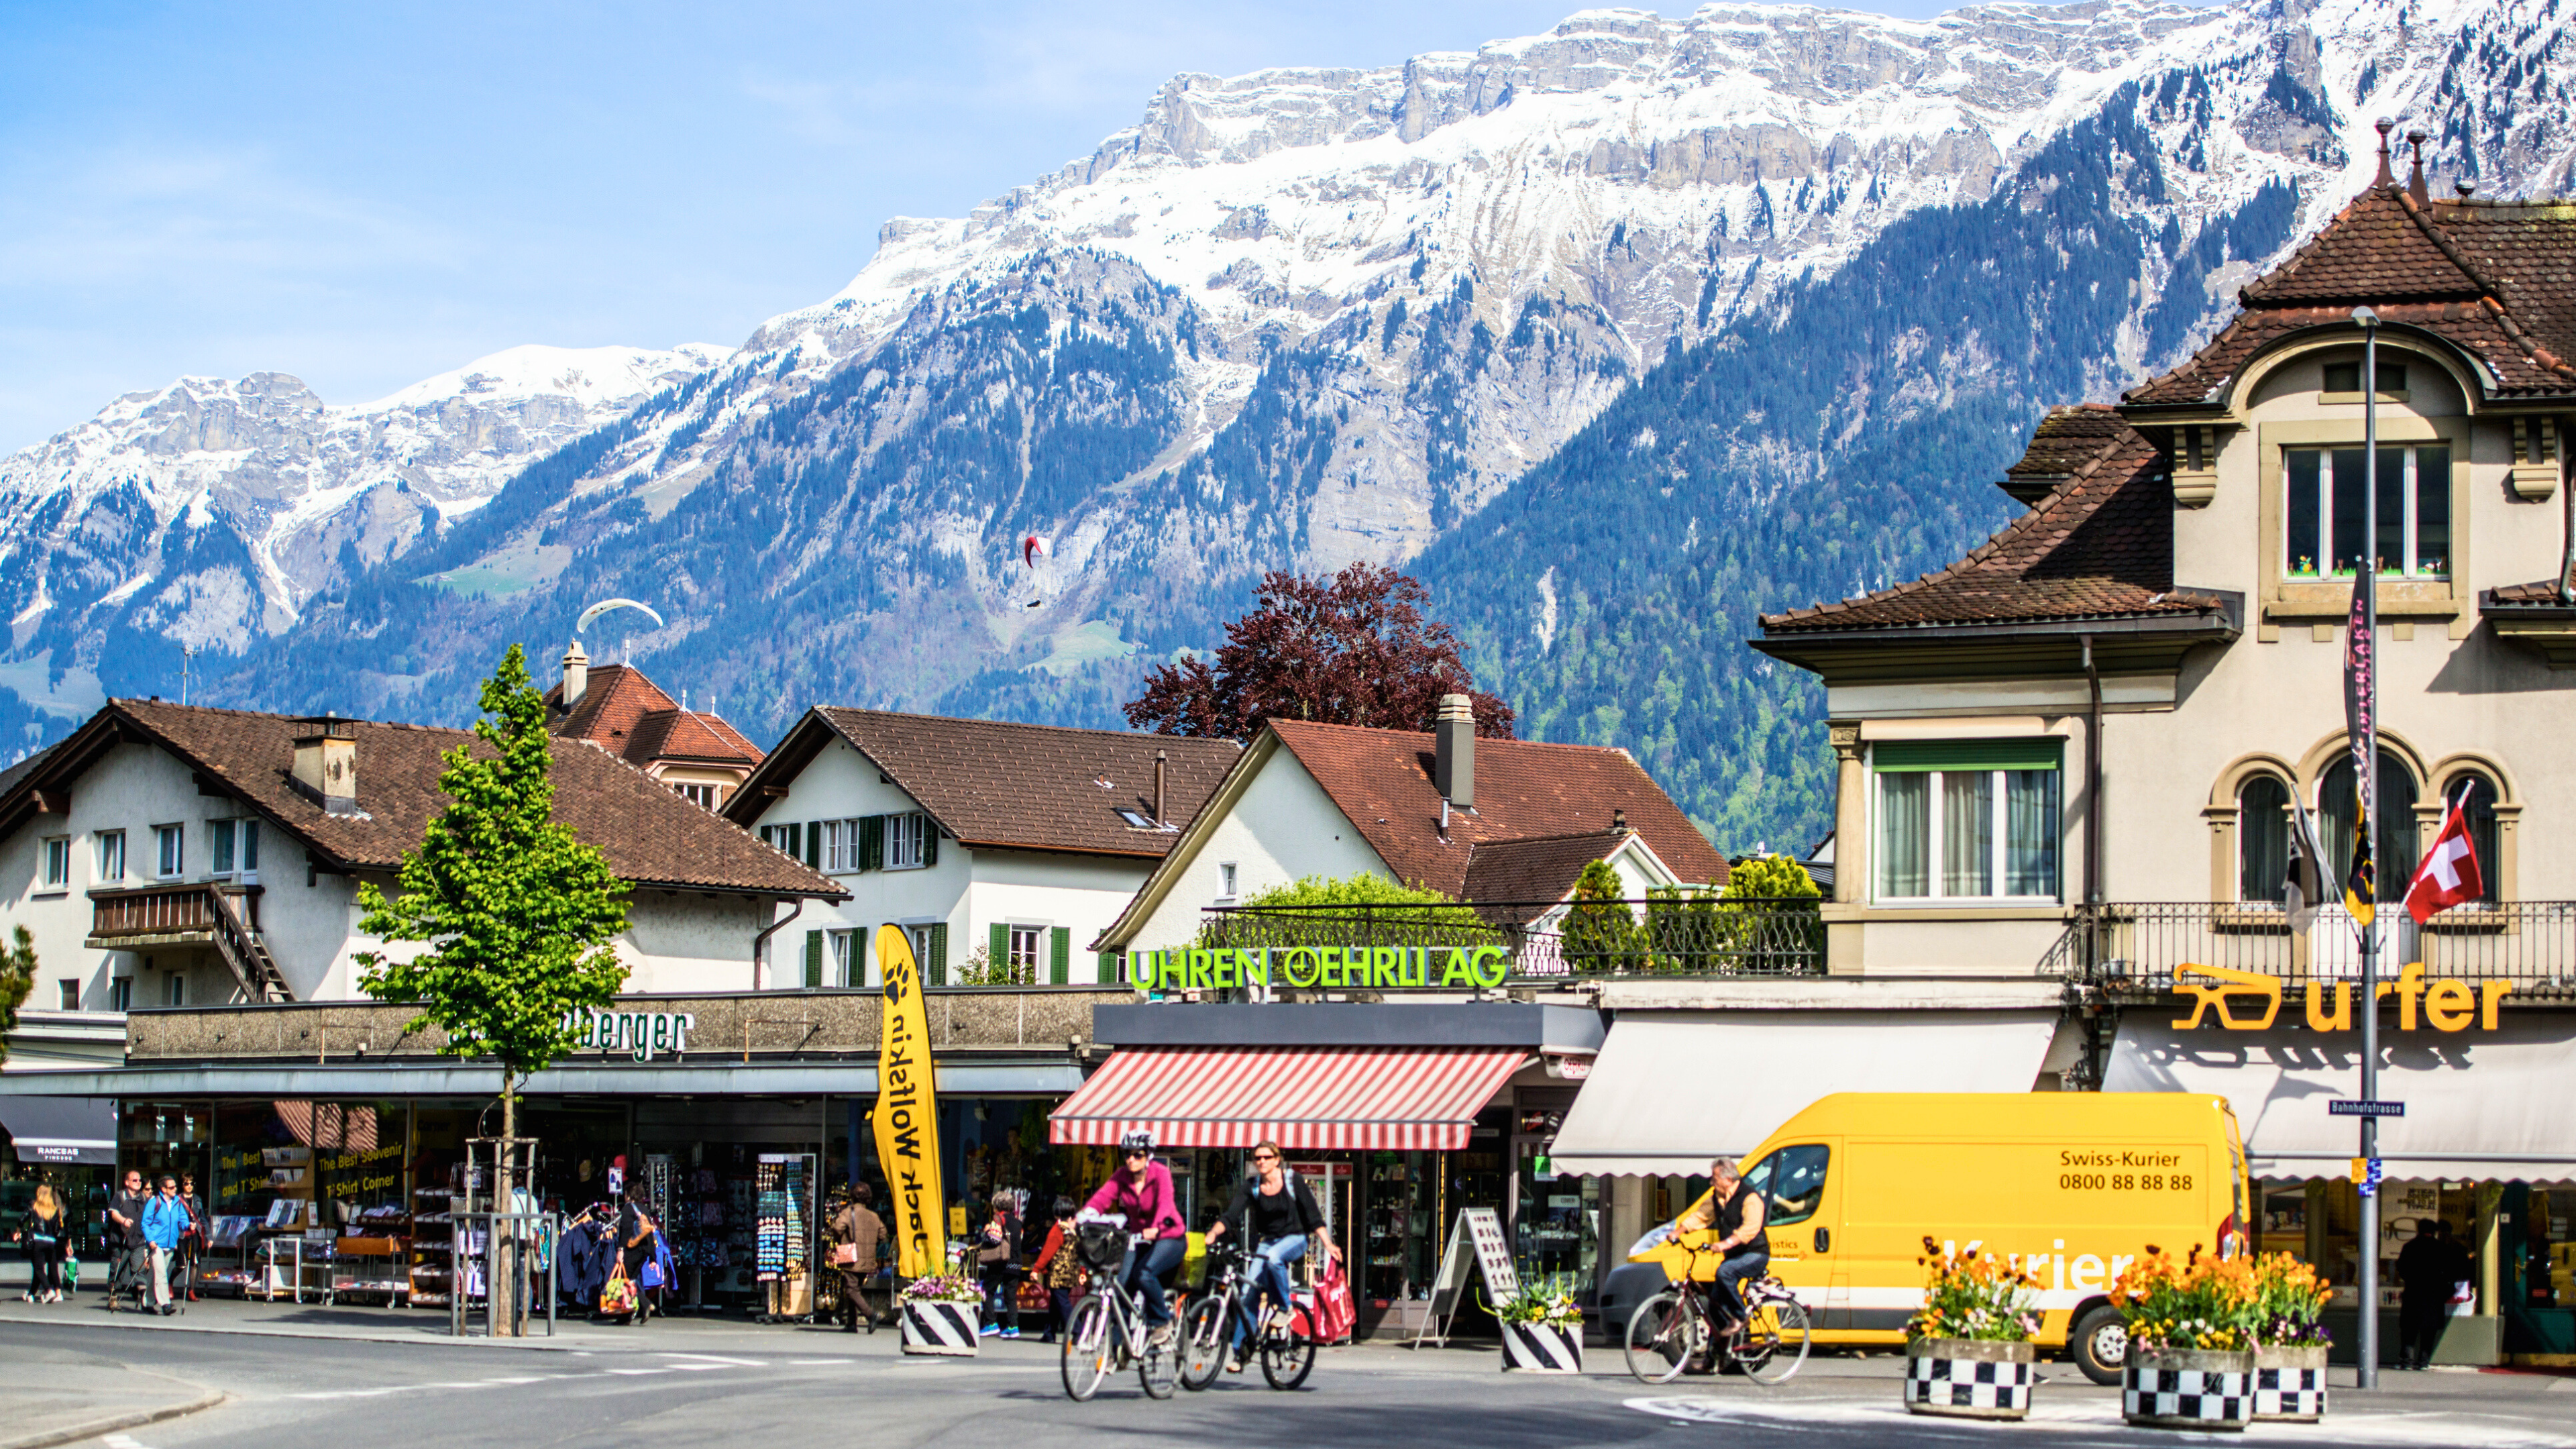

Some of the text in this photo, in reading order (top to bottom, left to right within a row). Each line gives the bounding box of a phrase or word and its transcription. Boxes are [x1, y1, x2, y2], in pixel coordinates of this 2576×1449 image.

[1130, 945, 1507, 989] UHREN OEHRLI AG
[2331, 1102, 2402, 1114] Bahnhofstrasse
[38, 1147, 79, 1155] RANCEAS
[319, 1142, 402, 1172] The Best Souvenir
[2060, 1150, 2180, 1167] Swiss-Kurier
[221, 1150, 260, 1170] The Best
[222, 1181, 237, 1197] and
[362, 1174, 394, 1191] Corner
[2059, 1174, 2192, 1190] 0800 88 88 88
[1770, 1238, 1799, 1249] istics
